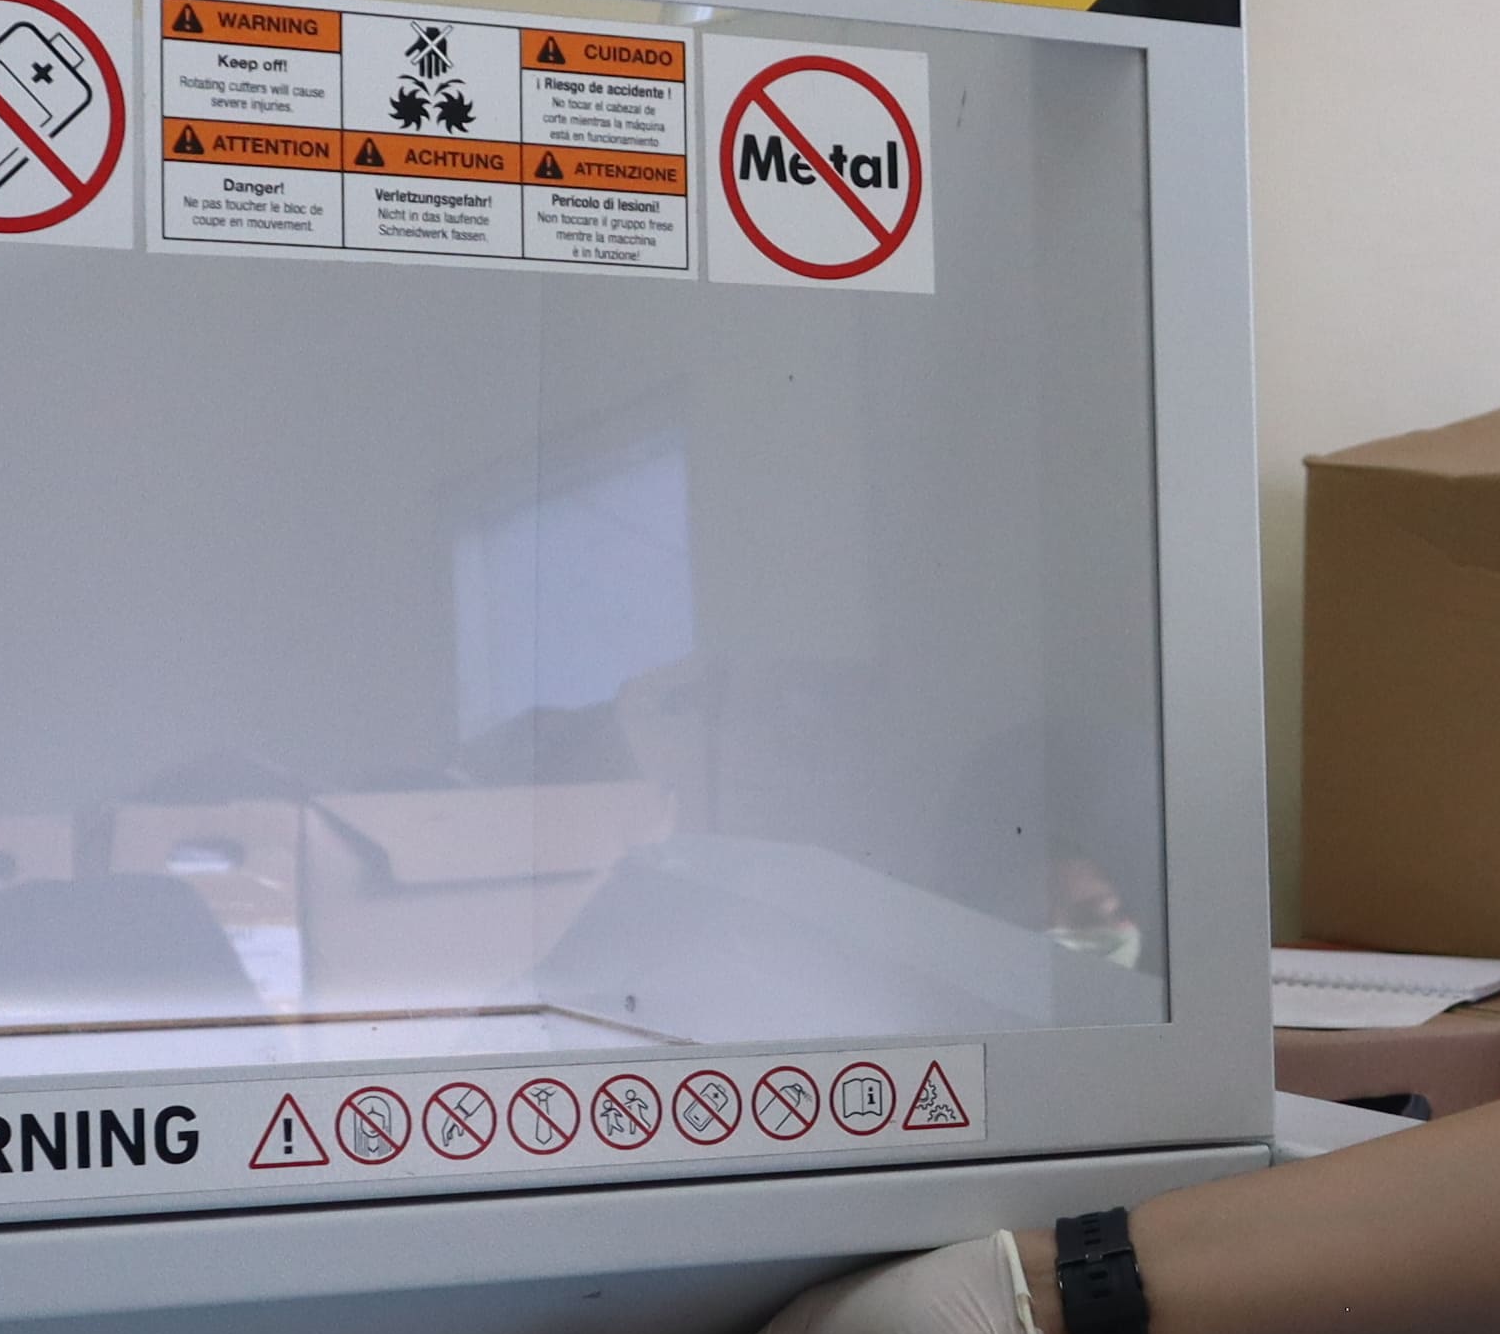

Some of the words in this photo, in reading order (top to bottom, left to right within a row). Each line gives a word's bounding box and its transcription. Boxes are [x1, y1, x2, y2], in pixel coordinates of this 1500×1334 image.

[217, 11, 318, 35] WARNING
[217, 54, 258, 71] Keep
[263, 60, 288, 72] off!
[584, 44, 673, 66] CUIDADO
[180, 76, 226, 93] Rotating
[228, 80, 267, 94] cutters
[271, 83, 289, 96] will
[292, 86, 325, 99] cause
[544, 77, 585, 95] Riesgo
[589, 81, 603, 94] de
[607, 85, 664, 100] accidente
[211, 97, 247, 109] severe
[251, 98, 293, 113] injuries.
[552, 97, 565, 108] No
[568, 99, 592, 110] tocar
[595, 101, 603, 111] el
[606, 102, 641, 114] cabezal
[644, 104, 655, 116] de
[543, 114, 567, 124] corte
[570, 115, 611, 128] mientras
[614, 117, 622, 129] la
[625, 118, 665, 133] máquina
[573, 131, 584, 141] en
[213, 135, 329, 158] ATTENTION
[405, 148, 505, 170] ACHTUNG
[739, 133, 899, 189] Metal
[574, 162, 677, 182] ATTENZIONE
[223, 178, 284, 196] Danger!
[184, 196, 198, 208] Ne
[202, 198, 222, 211] pas
[225, 199, 267, 212] toucher
[271, 201, 280, 213] le
[284, 202, 306, 214] bloc
[310, 203, 323, 216] de
[375, 188, 492, 208] Verletzungsgefahr!
[552, 194, 600, 210] Pericolo
[604, 197, 614, 210] di
[618, 198, 660, 213] lesioni!
[192, 216, 226, 227] coupe
[230, 217, 243, 227] en
[378, 208, 406, 222] Nicht
[409, 210, 419, 221] in
[422, 211, 441, 223] das
[444, 212, 490, 226] laufende
[537, 211, 558, 224] Non
[561, 213, 599, 226] toccare
[611, 217, 645, 231] gruppo
[649, 219, 674, 232] frese
[379, 224, 448, 240] Schneidwerk
[556, 230, 592, 242] mentre
[596, 231, 604, 243] la
[608, 233, 656, 246] macchina
[582, 247, 592, 258] in
